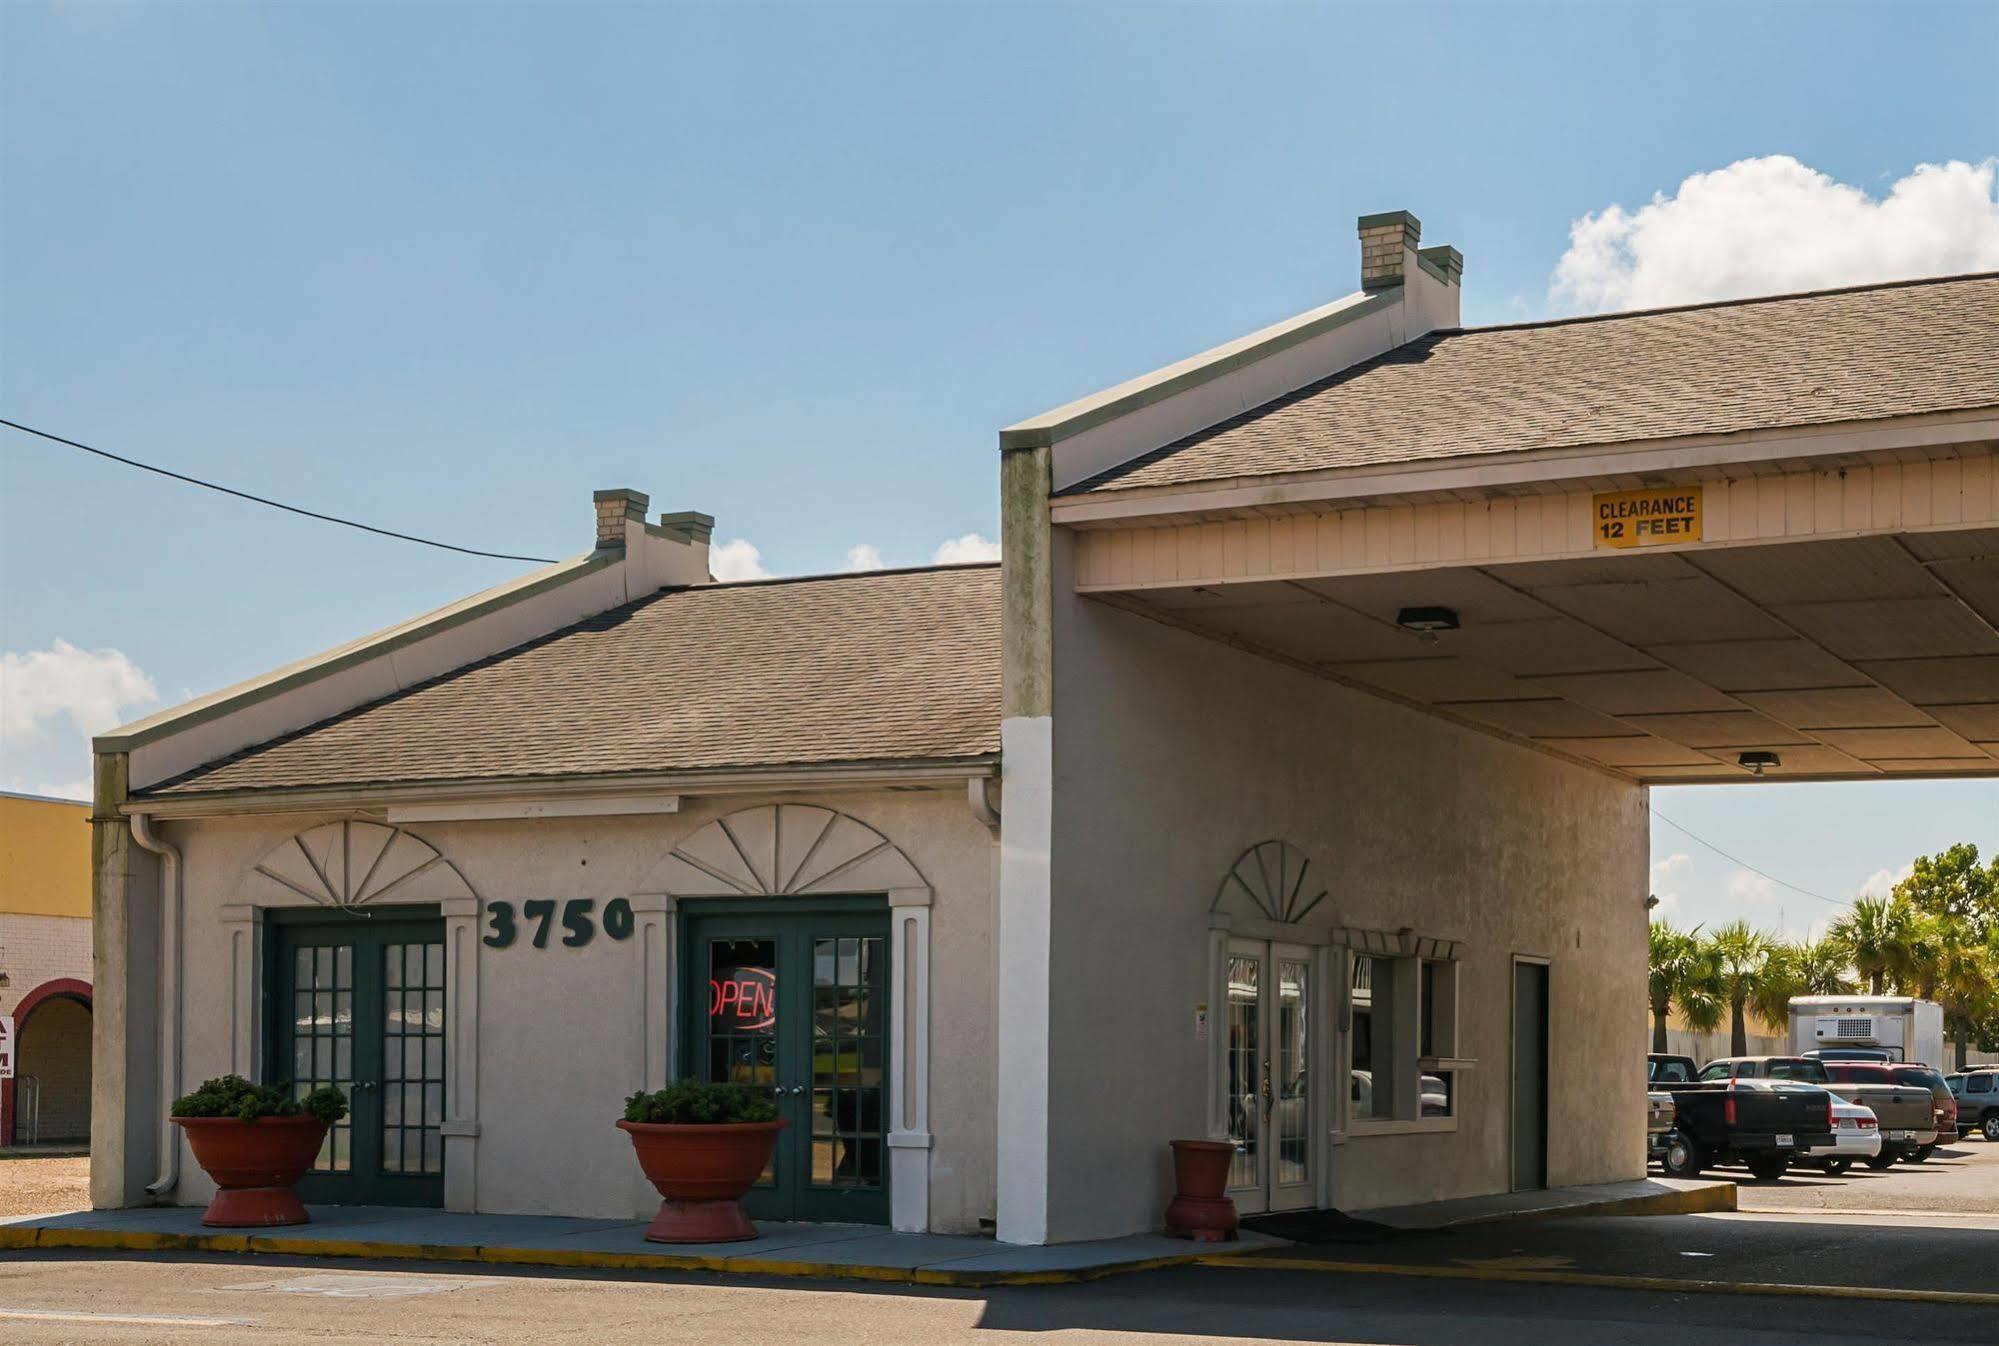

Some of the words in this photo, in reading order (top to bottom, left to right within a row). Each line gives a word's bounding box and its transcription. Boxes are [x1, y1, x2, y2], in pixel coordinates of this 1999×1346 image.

[1600, 497, 1696, 519] CLEARANCE
[1601, 521, 1624, 538] 12
[1636, 516, 1694, 536] FEET
[483, 898, 634, 948] 3750
